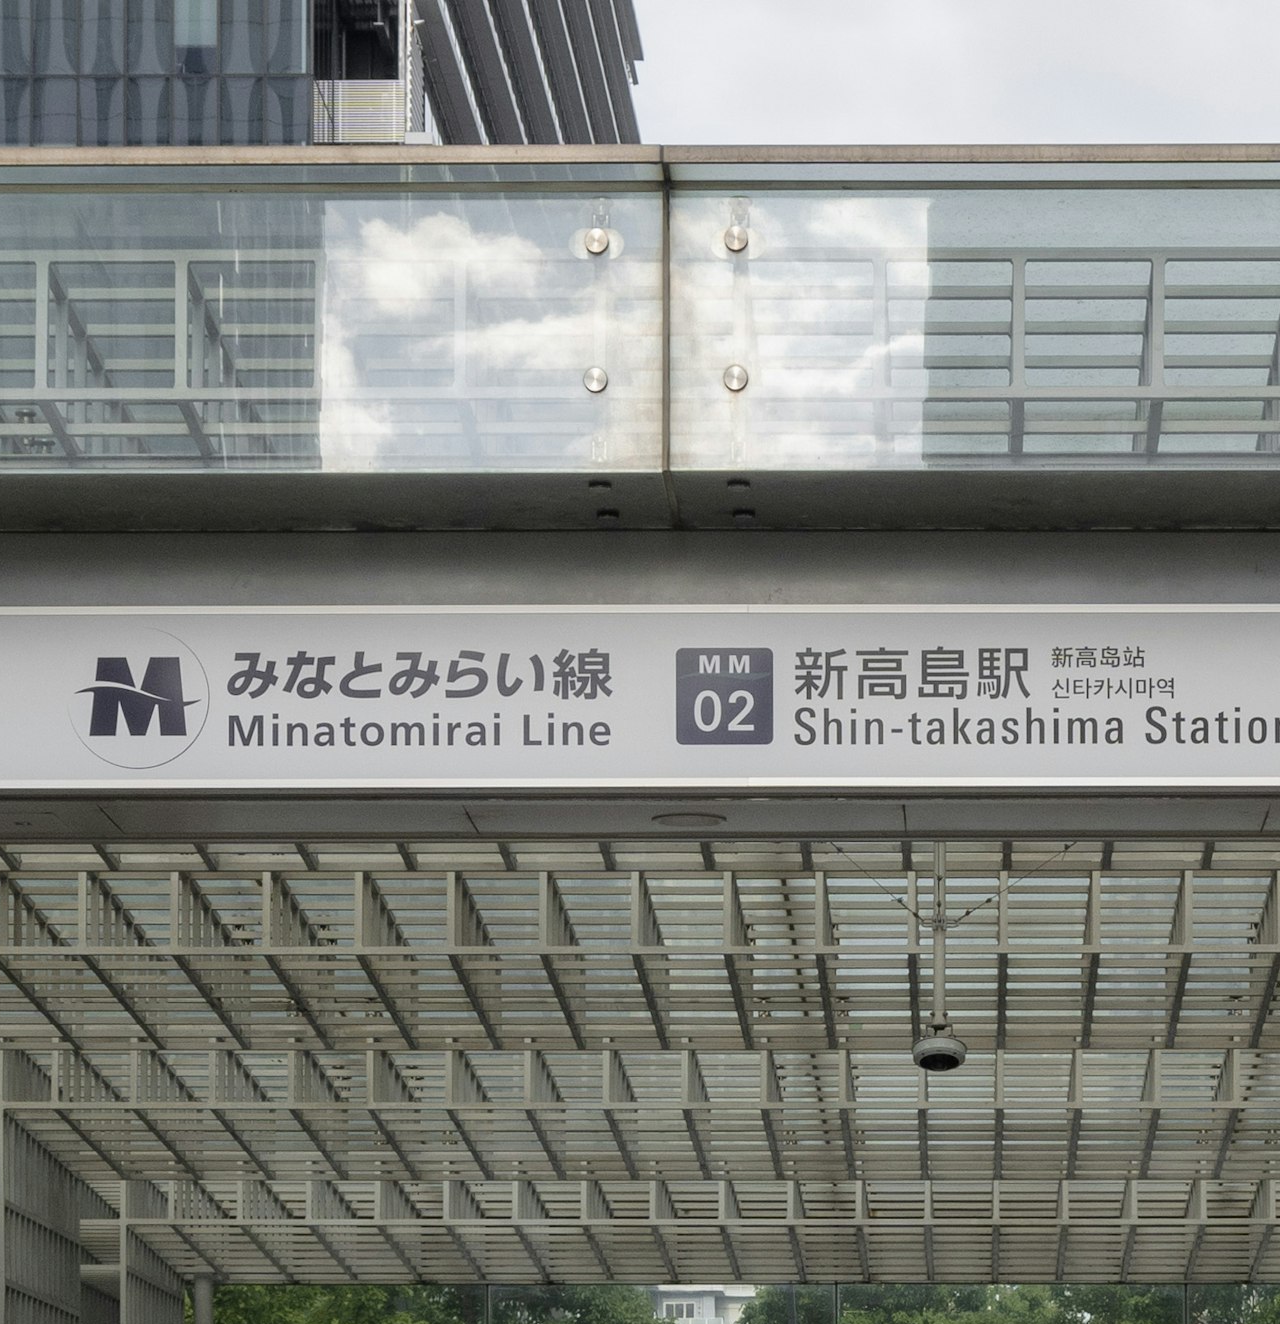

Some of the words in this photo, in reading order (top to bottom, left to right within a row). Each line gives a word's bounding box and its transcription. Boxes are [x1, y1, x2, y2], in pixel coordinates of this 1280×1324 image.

[226, 647, 613, 700] みなとみらい線
[698, 654, 750, 675] MM
[794, 645, 1031, 700] 新高島駅
[1051, 645, 1146, 669] 新高岛站
[1051, 677, 1175, 700] 신타카시마역
[693, 689, 755, 732] 02
[794, 706, 1124, 746] Shin-takashima
[228, 712, 501, 747] Minatomirai
[523, 712, 611, 746] Line
